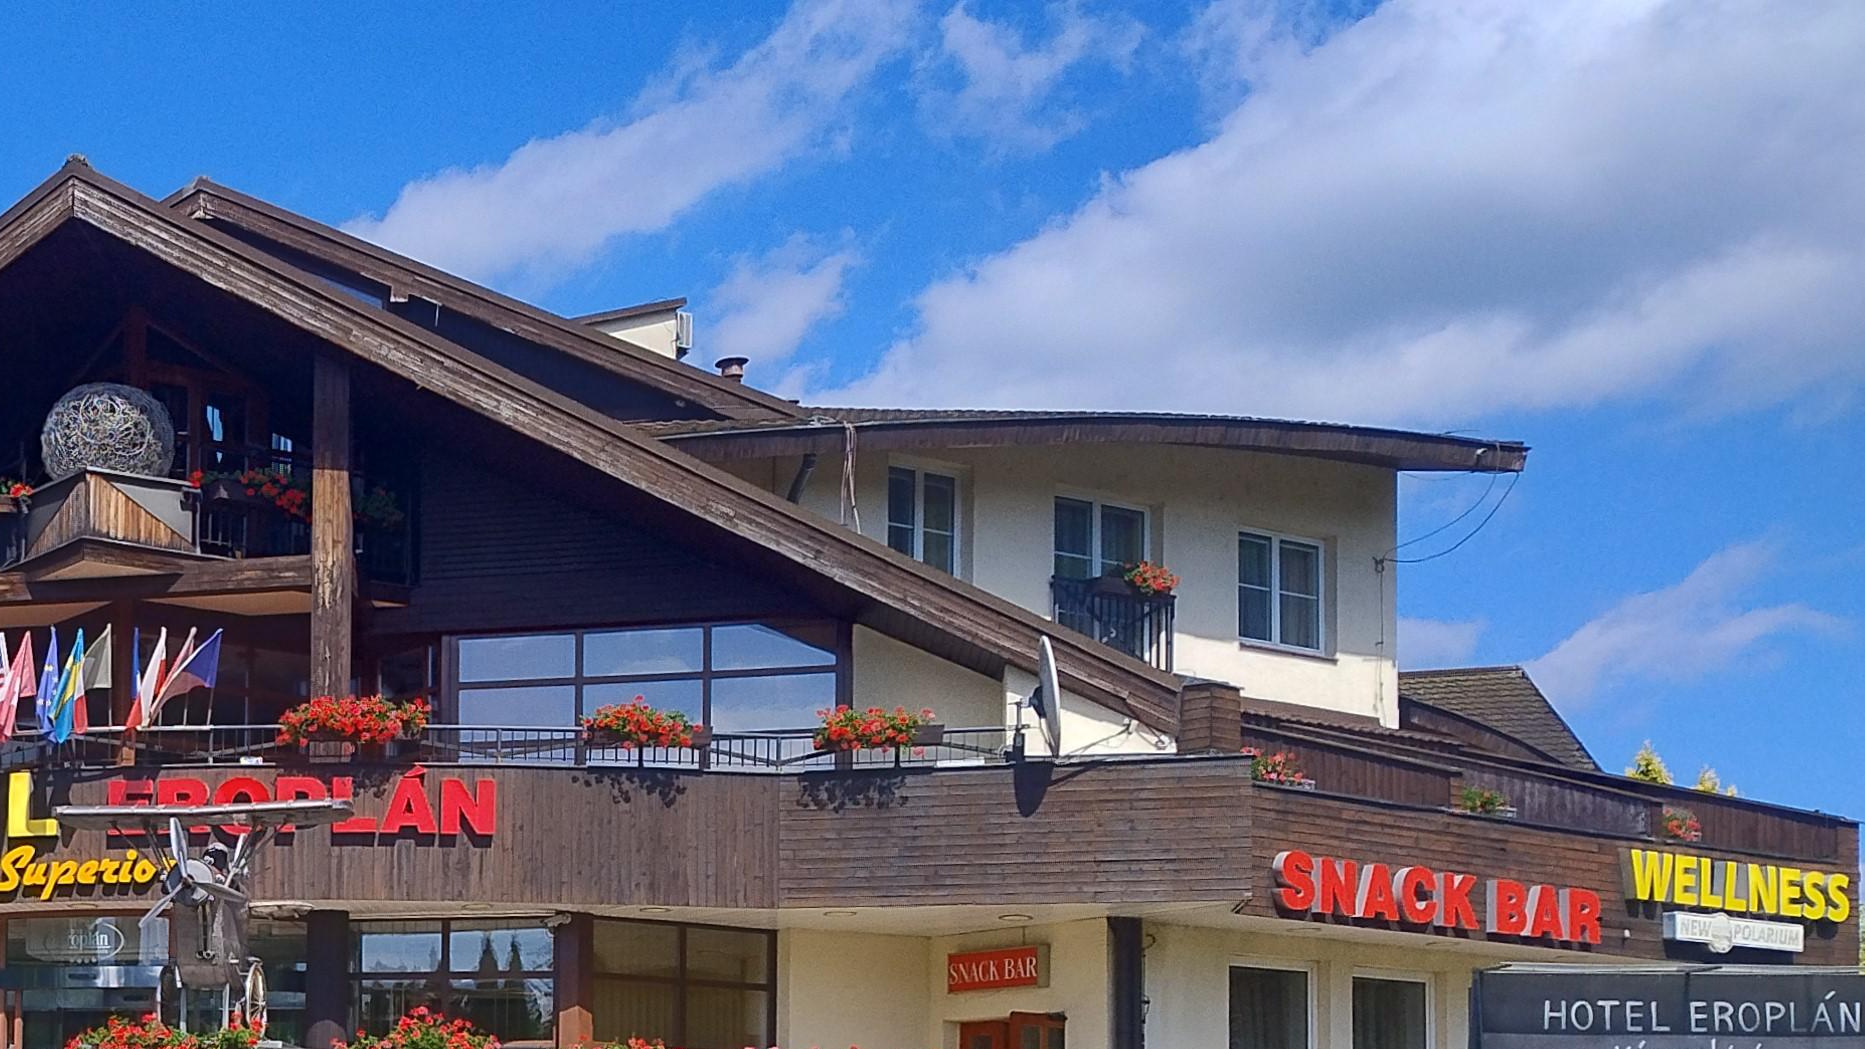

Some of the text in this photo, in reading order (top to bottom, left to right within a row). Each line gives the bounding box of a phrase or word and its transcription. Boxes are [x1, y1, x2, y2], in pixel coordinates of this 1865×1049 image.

[1273, 849, 1602, 945] SNACK BAR
[1630, 848, 1851, 923] WELLNESS
[1680, 917, 1801, 947] NEW POLARIUM
[949, 956, 1038, 985] SNACK BAR
[1543, 990, 1862, 1033] HOTEL EROPLÁN
